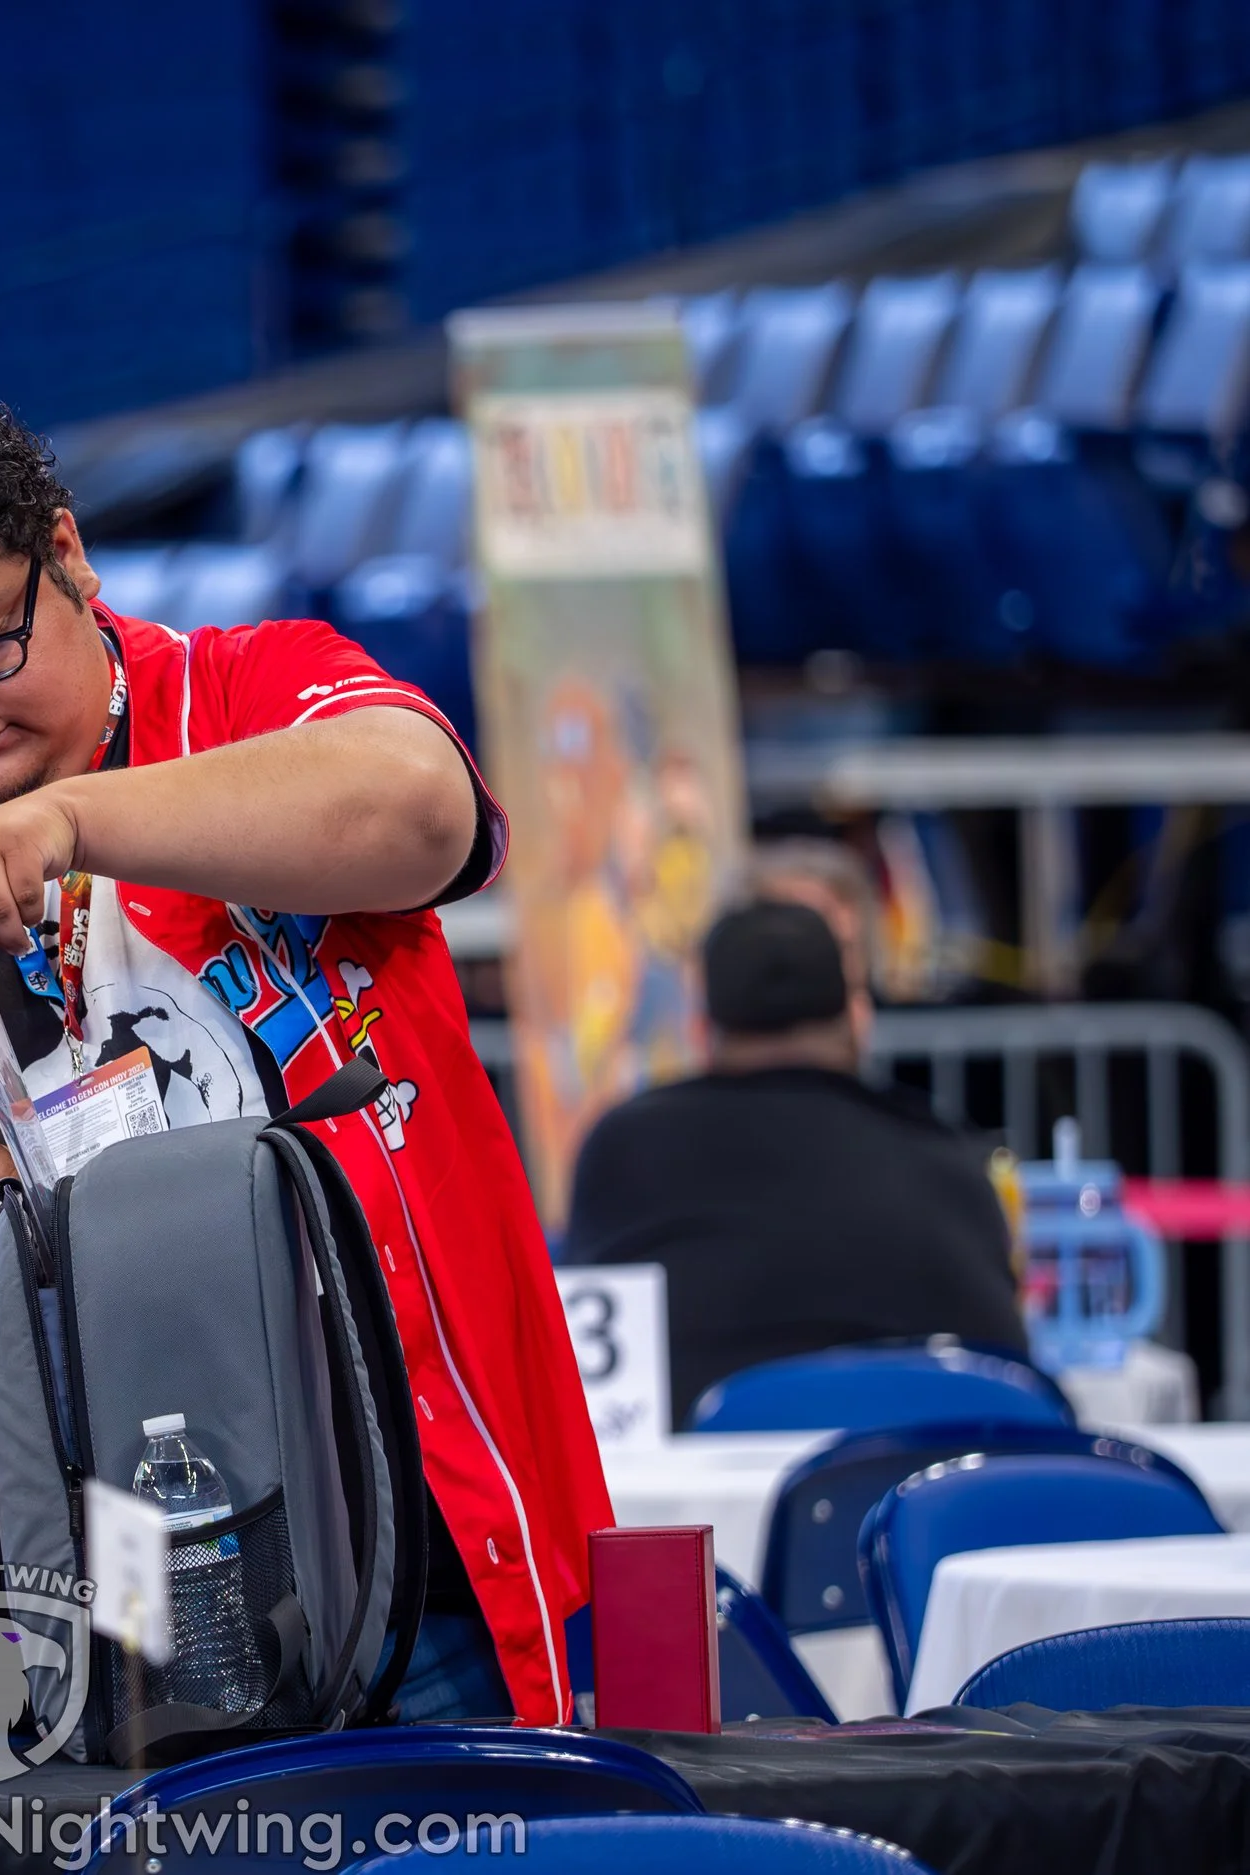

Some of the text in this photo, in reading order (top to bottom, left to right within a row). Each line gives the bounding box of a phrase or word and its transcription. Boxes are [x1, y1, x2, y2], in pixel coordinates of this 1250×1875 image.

[109, 661, 127, 716] BOYS
[64, 943, 72, 965] THE
[71, 907, 90, 968] BOYS
[37, 1101, 67, 1121] ELCOME
[68, 1095, 78, 1107] TO
[78, 1089, 94, 1102] GEN
[94, 1081, 110, 1096] CON
[110, 1072, 127, 1088] INDY
[127, 1062, 146, 1078] 2023
